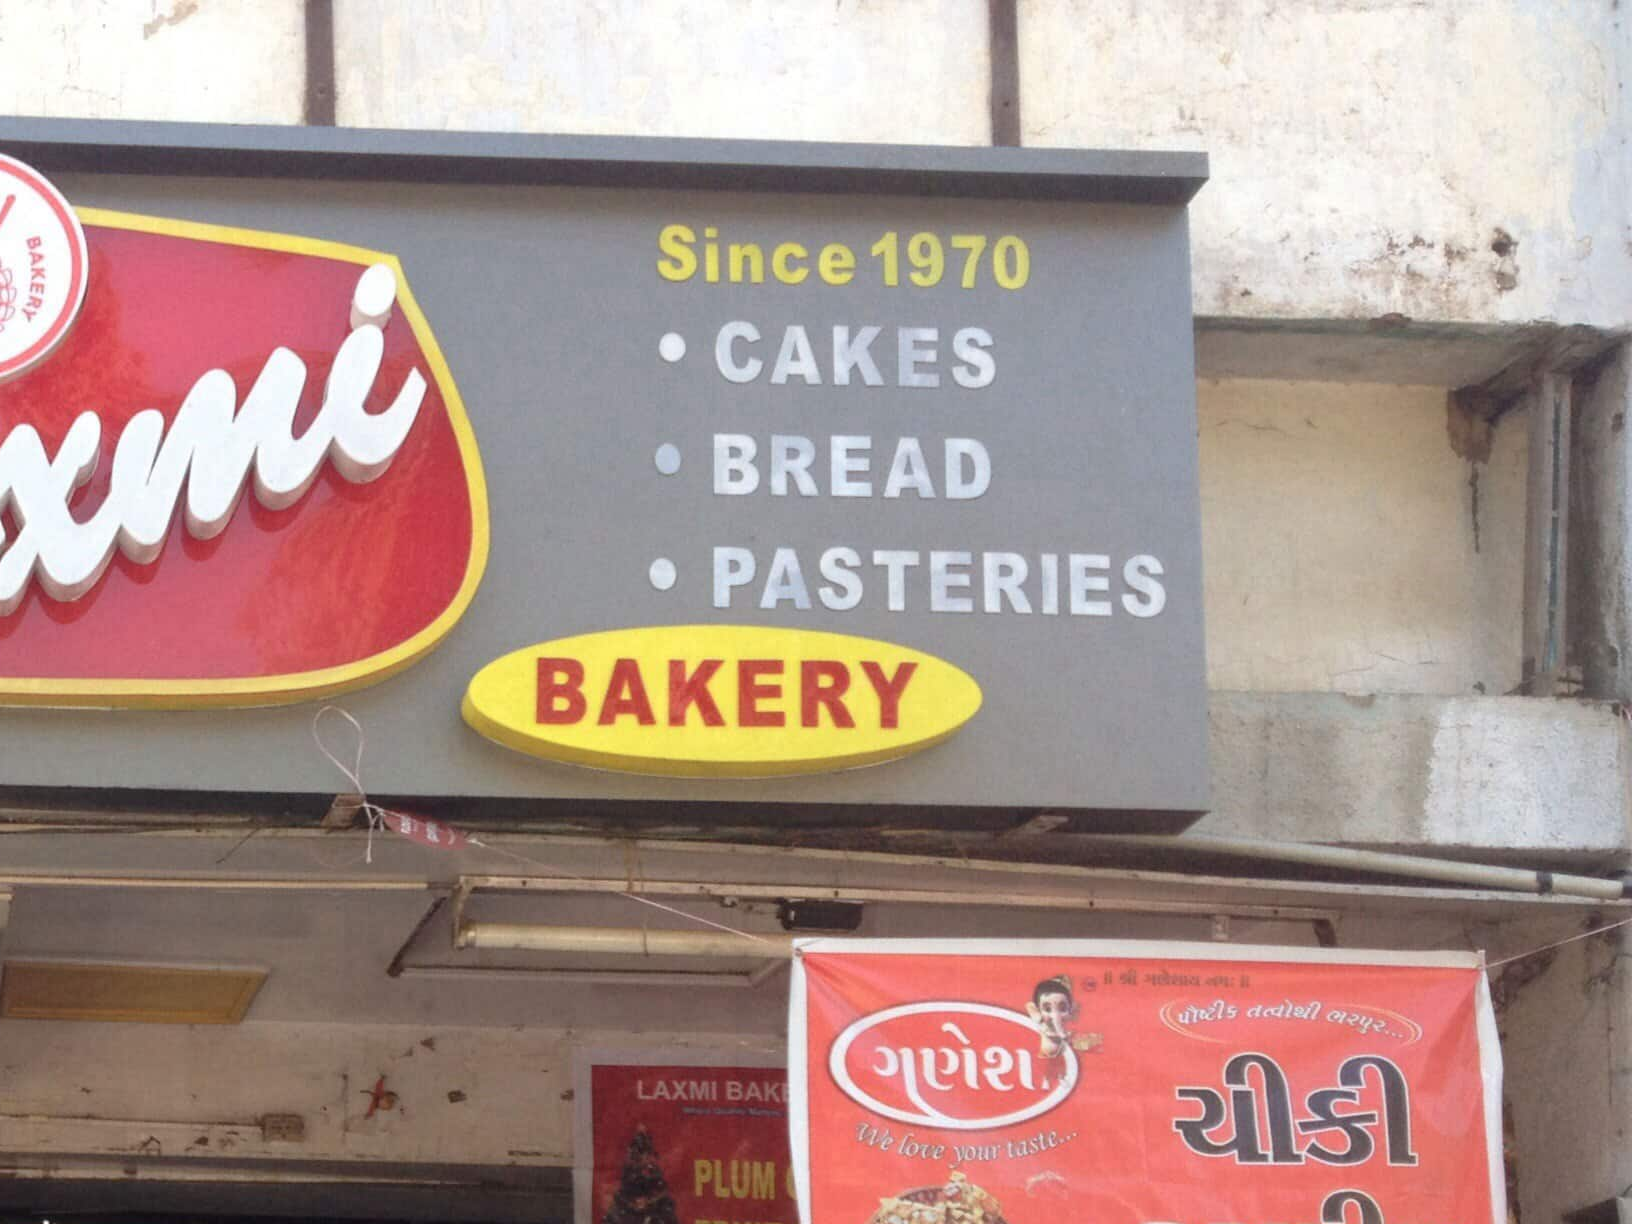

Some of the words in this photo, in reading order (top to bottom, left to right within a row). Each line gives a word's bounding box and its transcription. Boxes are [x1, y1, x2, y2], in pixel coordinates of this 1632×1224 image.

[22, 235, 46, 323] BAKERY
[656, 224, 857, 285] Since
[870, 231, 1030, 290] 1970
[714, 320, 997, 389] CAKES
[713, 433, 993, 499] BREAD
[713, 546, 1167, 617] PASTERIES
[534, 657, 918, 729] BAKERY
[637, 1080, 717, 1100] LAXMI
[872, 1022, 1035, 1118] ગણેશ
[1173, 1052, 1419, 1167] ચીકી
[694, 1160, 776, 1200] PLUM
[855, 1123, 894, 1150] We
[899, 1133, 945, 1160] love
[953, 1145, 1000, 1168] your
[1007, 1129, 1077, 1156] taste...
